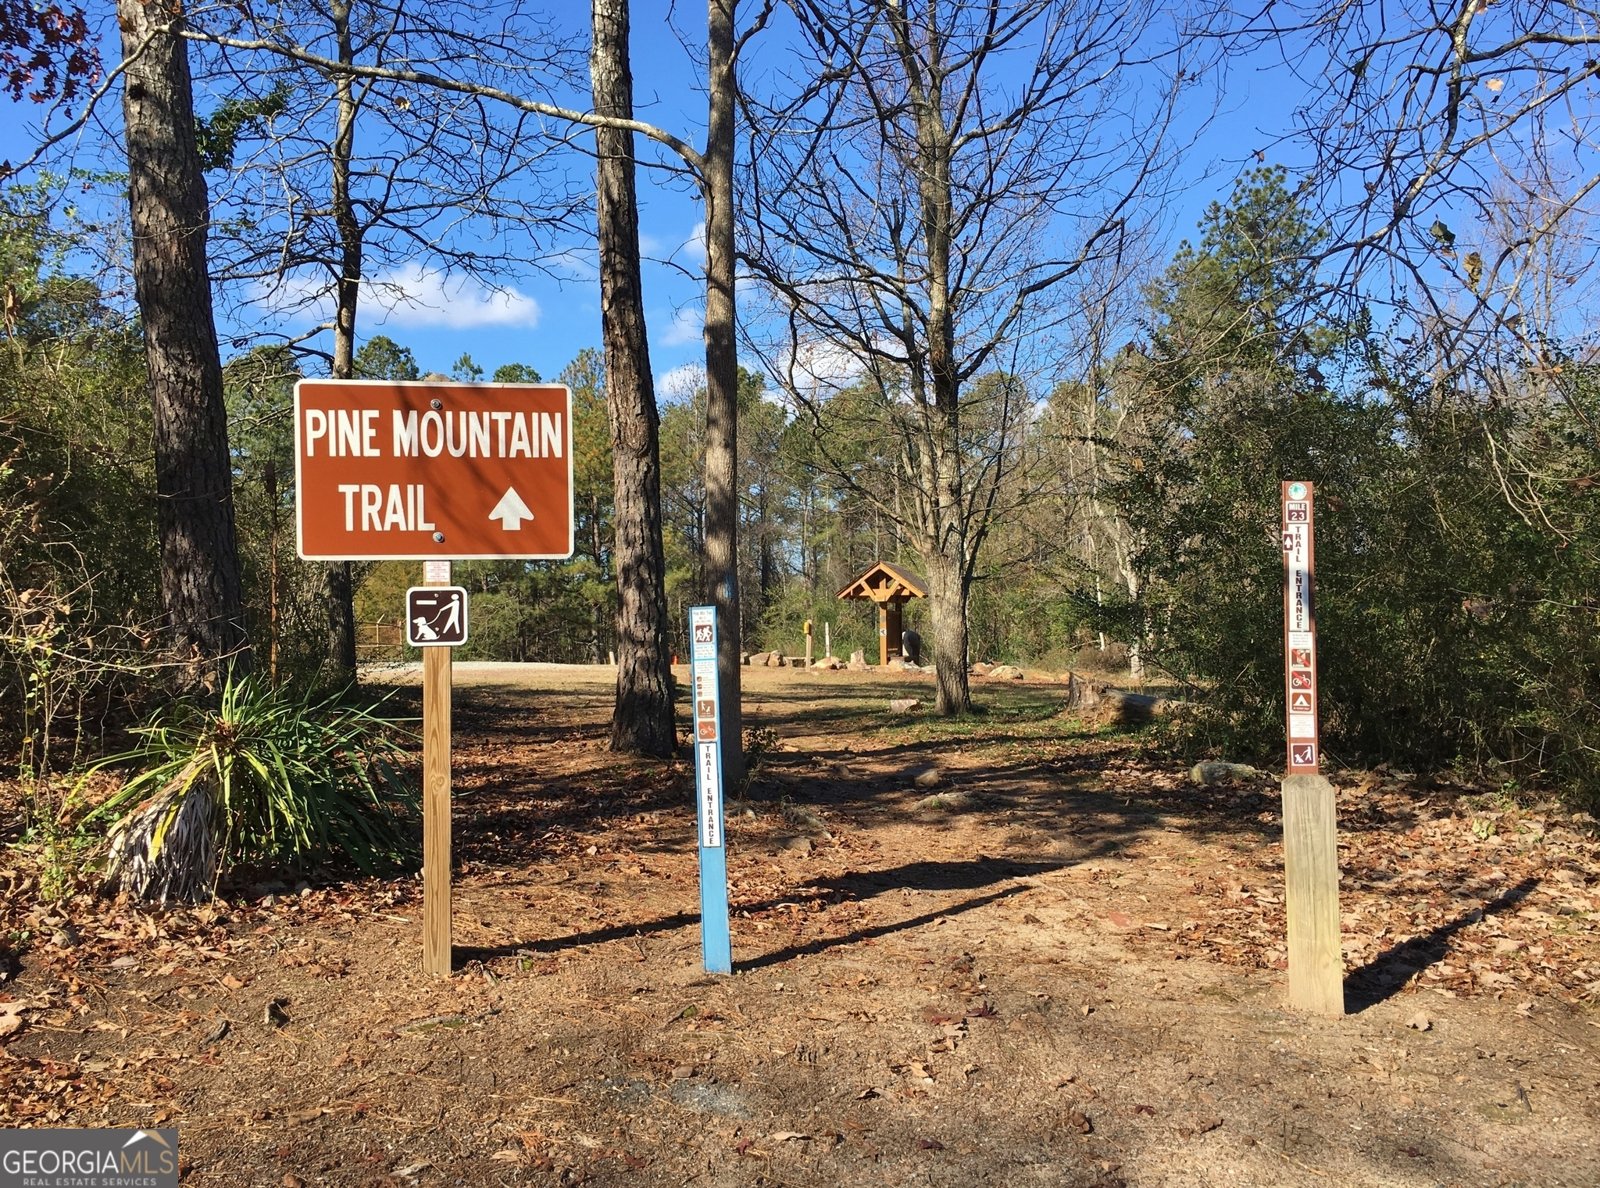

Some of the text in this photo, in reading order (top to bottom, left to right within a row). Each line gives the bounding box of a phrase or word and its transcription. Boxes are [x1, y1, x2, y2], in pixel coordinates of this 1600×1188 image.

[305, 409, 563, 458] PINE MOUNTAIN
[338, 484, 436, 532] TRAIL
[1288, 503, 1306, 511] MILE
[1291, 511, 1305, 521] 23
